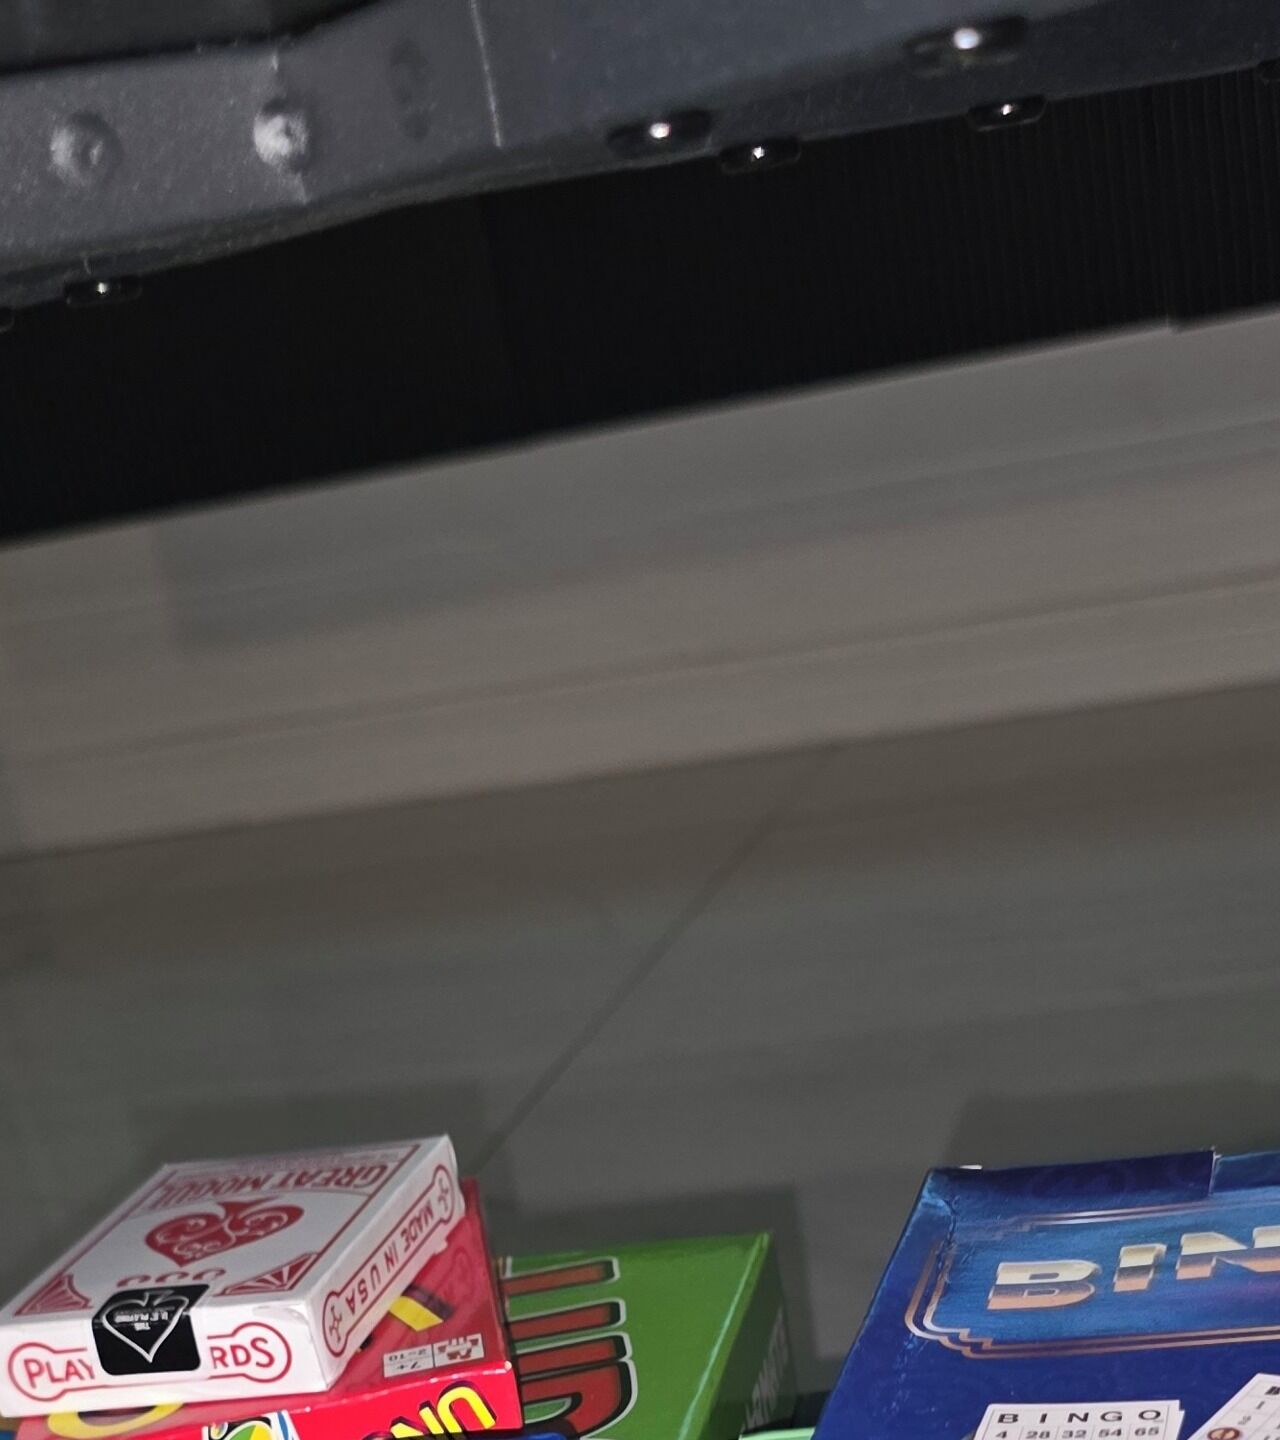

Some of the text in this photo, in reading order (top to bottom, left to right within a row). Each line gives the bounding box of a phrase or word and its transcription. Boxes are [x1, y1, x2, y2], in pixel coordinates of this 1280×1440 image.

[278, 1165, 388, 1188] GREAT
[345, 1198, 434, 1314] MADE IN USA
[24, 1337, 275, 1389] PLAY RDS
[998, 1410, 1161, 1423] B I N G O
